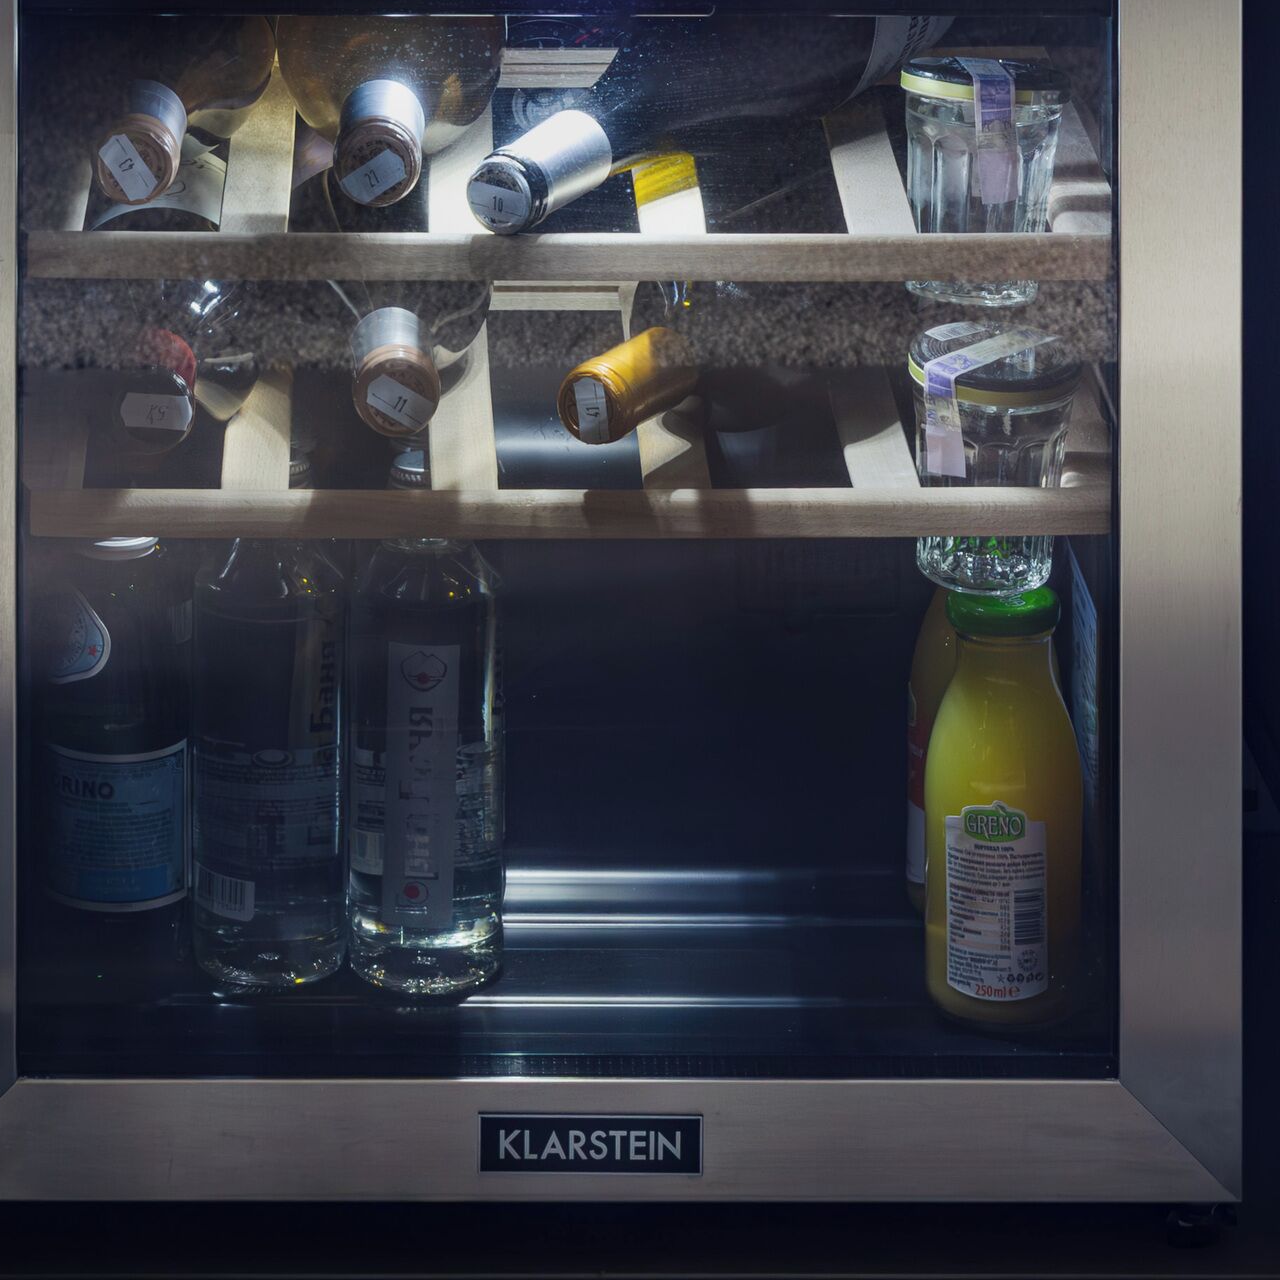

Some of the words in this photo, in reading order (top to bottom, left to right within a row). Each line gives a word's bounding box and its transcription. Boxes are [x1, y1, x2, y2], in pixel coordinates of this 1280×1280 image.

[492, 195, 504, 213] 10
[966, 813, 1022, 839] GRENO
[499, 1129, 682, 1161] KLARSTEIN
